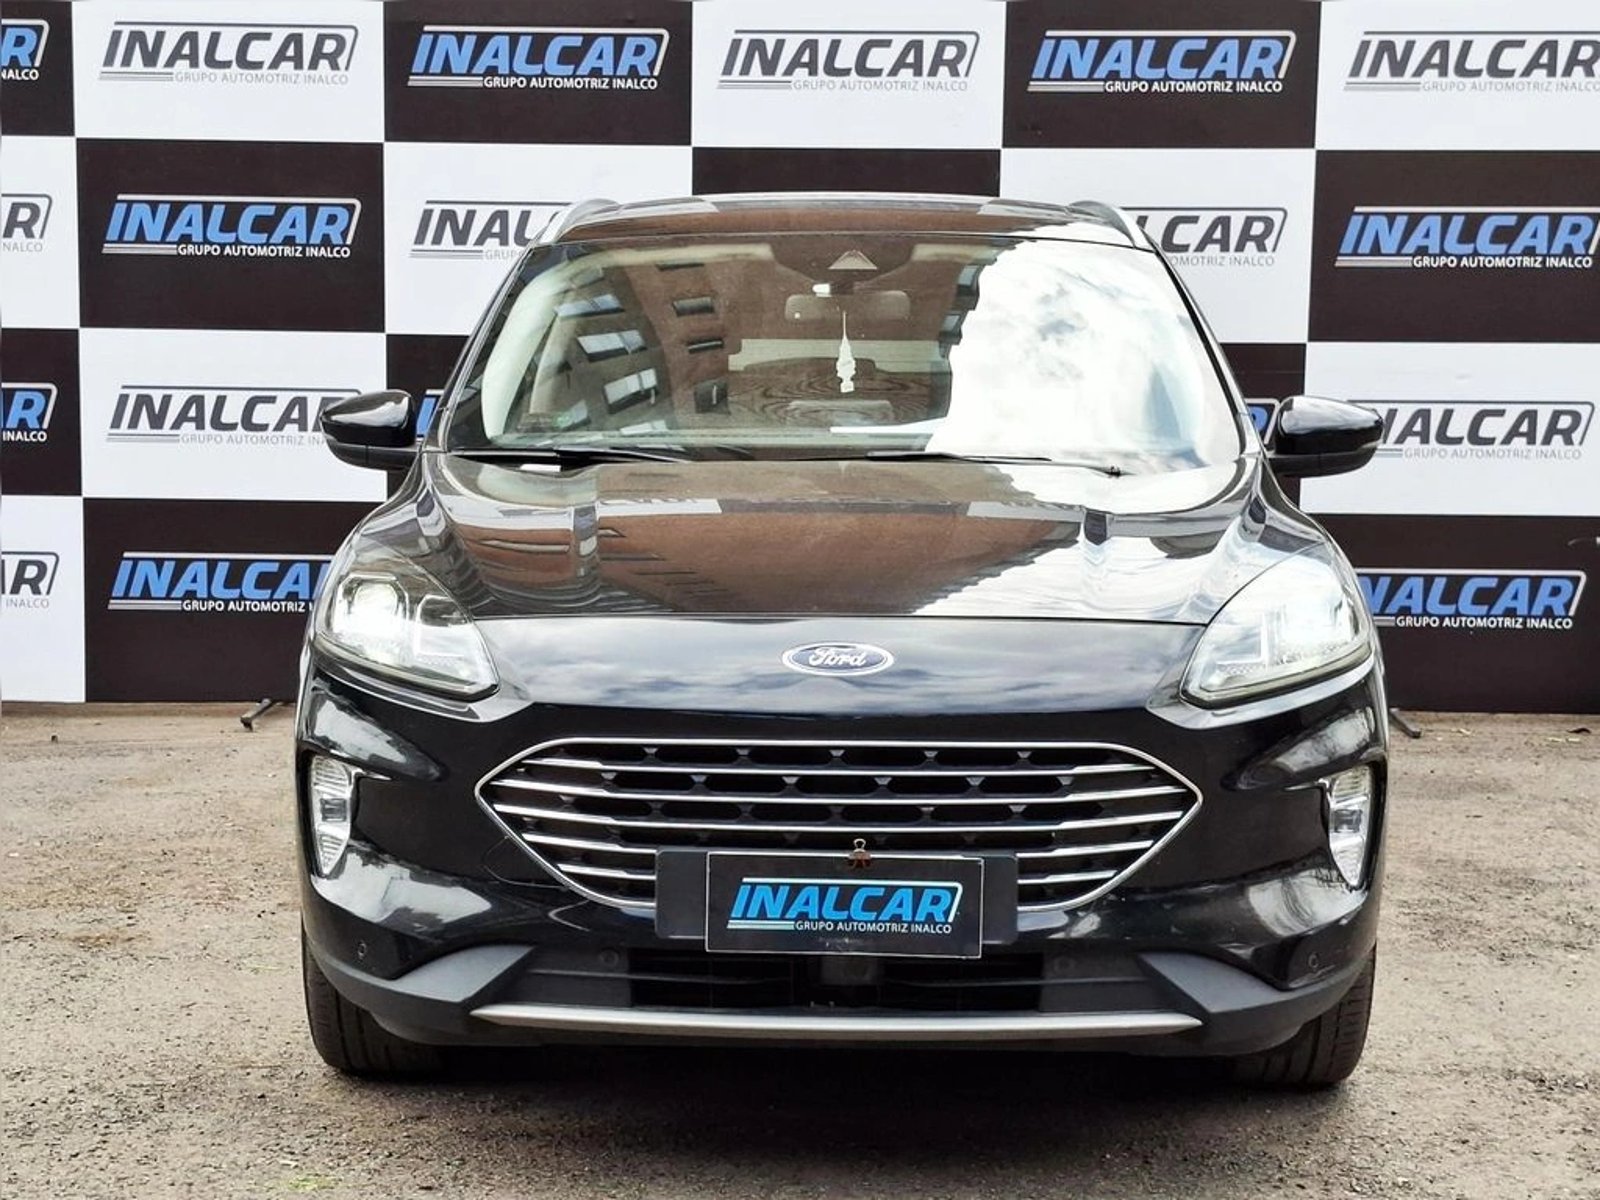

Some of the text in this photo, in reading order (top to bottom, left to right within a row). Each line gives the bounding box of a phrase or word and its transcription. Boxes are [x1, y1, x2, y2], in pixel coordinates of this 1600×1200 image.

[102, 30, 347, 71] INALCAR
[411, 34, 657, 76] INALCAR
[720, 38, 967, 77] INALCAR
[1031, 38, 1284, 79] INALCAR
[1348, 39, 1600, 78] INALCAR
[1, 69, 40, 80] NALCO
[175, 72, 348, 85] GRUPO AUTOMOTRIZ INALCO
[484, 76, 658, 90] GRUPO AUTOMOTRIZ INALCO
[793, 79, 968, 91] GRUPO AUTOMOTRIZ INALCO
[1105, 80, 1283, 92] GRUPO AUTOMOTRIZ INALCO
[1422, 81, 1466, 92] GRUPO
[1470, 81, 1552, 92] AUTOMOTRIZ
[105, 202, 350, 245] INALCAR
[413, 208, 534, 248] INAL
[1338, 214, 1595, 255] INALCAR
[2, 242, 43, 252] NALCO
[178, 244, 350, 258] GRUPO AUTOMOTRIZ INALCO
[1169, 255, 1275, 266] OMOTRIZ INALCO
[1413, 255, 1593, 268] GRUPO AUTOMOTRIZ INALCO
[1383, 407, 1582, 447] ALCAR
[2, 430, 47, 442] INALCO
[181, 433, 223, 444] GRUPO
[226, 434, 303, 446] AUTOMOTRIZ
[1404, 448, 1582, 460] GRUPO AUTOMOTRIZ INALCO
[111, 560, 329, 600] INALCA
[1358, 576, 1574, 616] NALCAR
[183, 600, 225, 611] GRUPO
[228, 600, 305, 613] AUTOMOTRIZ
[1396, 616, 1573, 629] GRUPO AUTOMOTRIZ INALCO
[808, 647, 867, 666] Ford
[730, 884, 953, 922] INALCAR
[796, 920, 952, 935] GRUPO AUTOMOTRIZ INALCO
